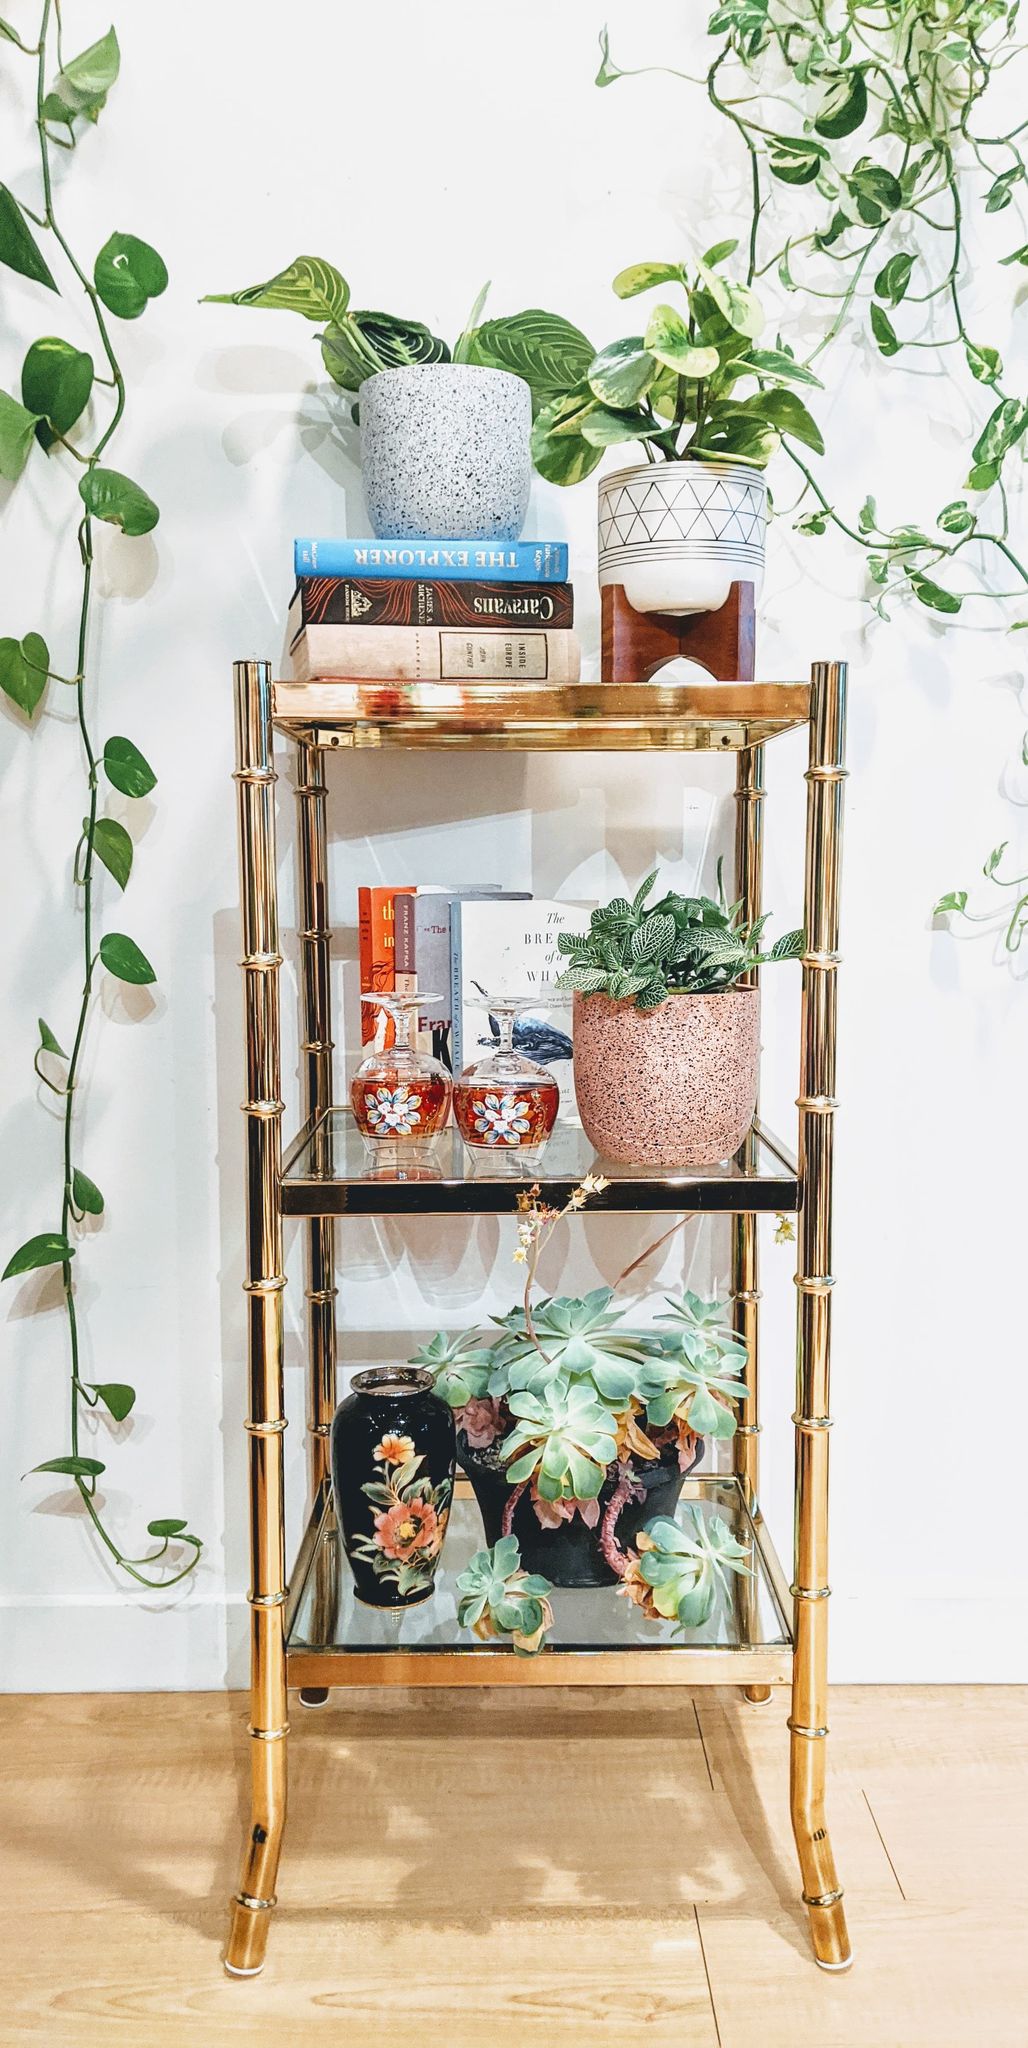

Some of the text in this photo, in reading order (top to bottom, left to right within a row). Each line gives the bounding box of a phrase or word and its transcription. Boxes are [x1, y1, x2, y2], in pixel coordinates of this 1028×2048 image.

[353, 548, 520, 568] THE EXPLORER
[473, 596, 554, 620] Caravans
[504, 643, 513, 669] EUROPE
[518, 643, 527, 669] INSIDE
[547, 912, 565, 924] The
[545, 950, 557, 965] of
